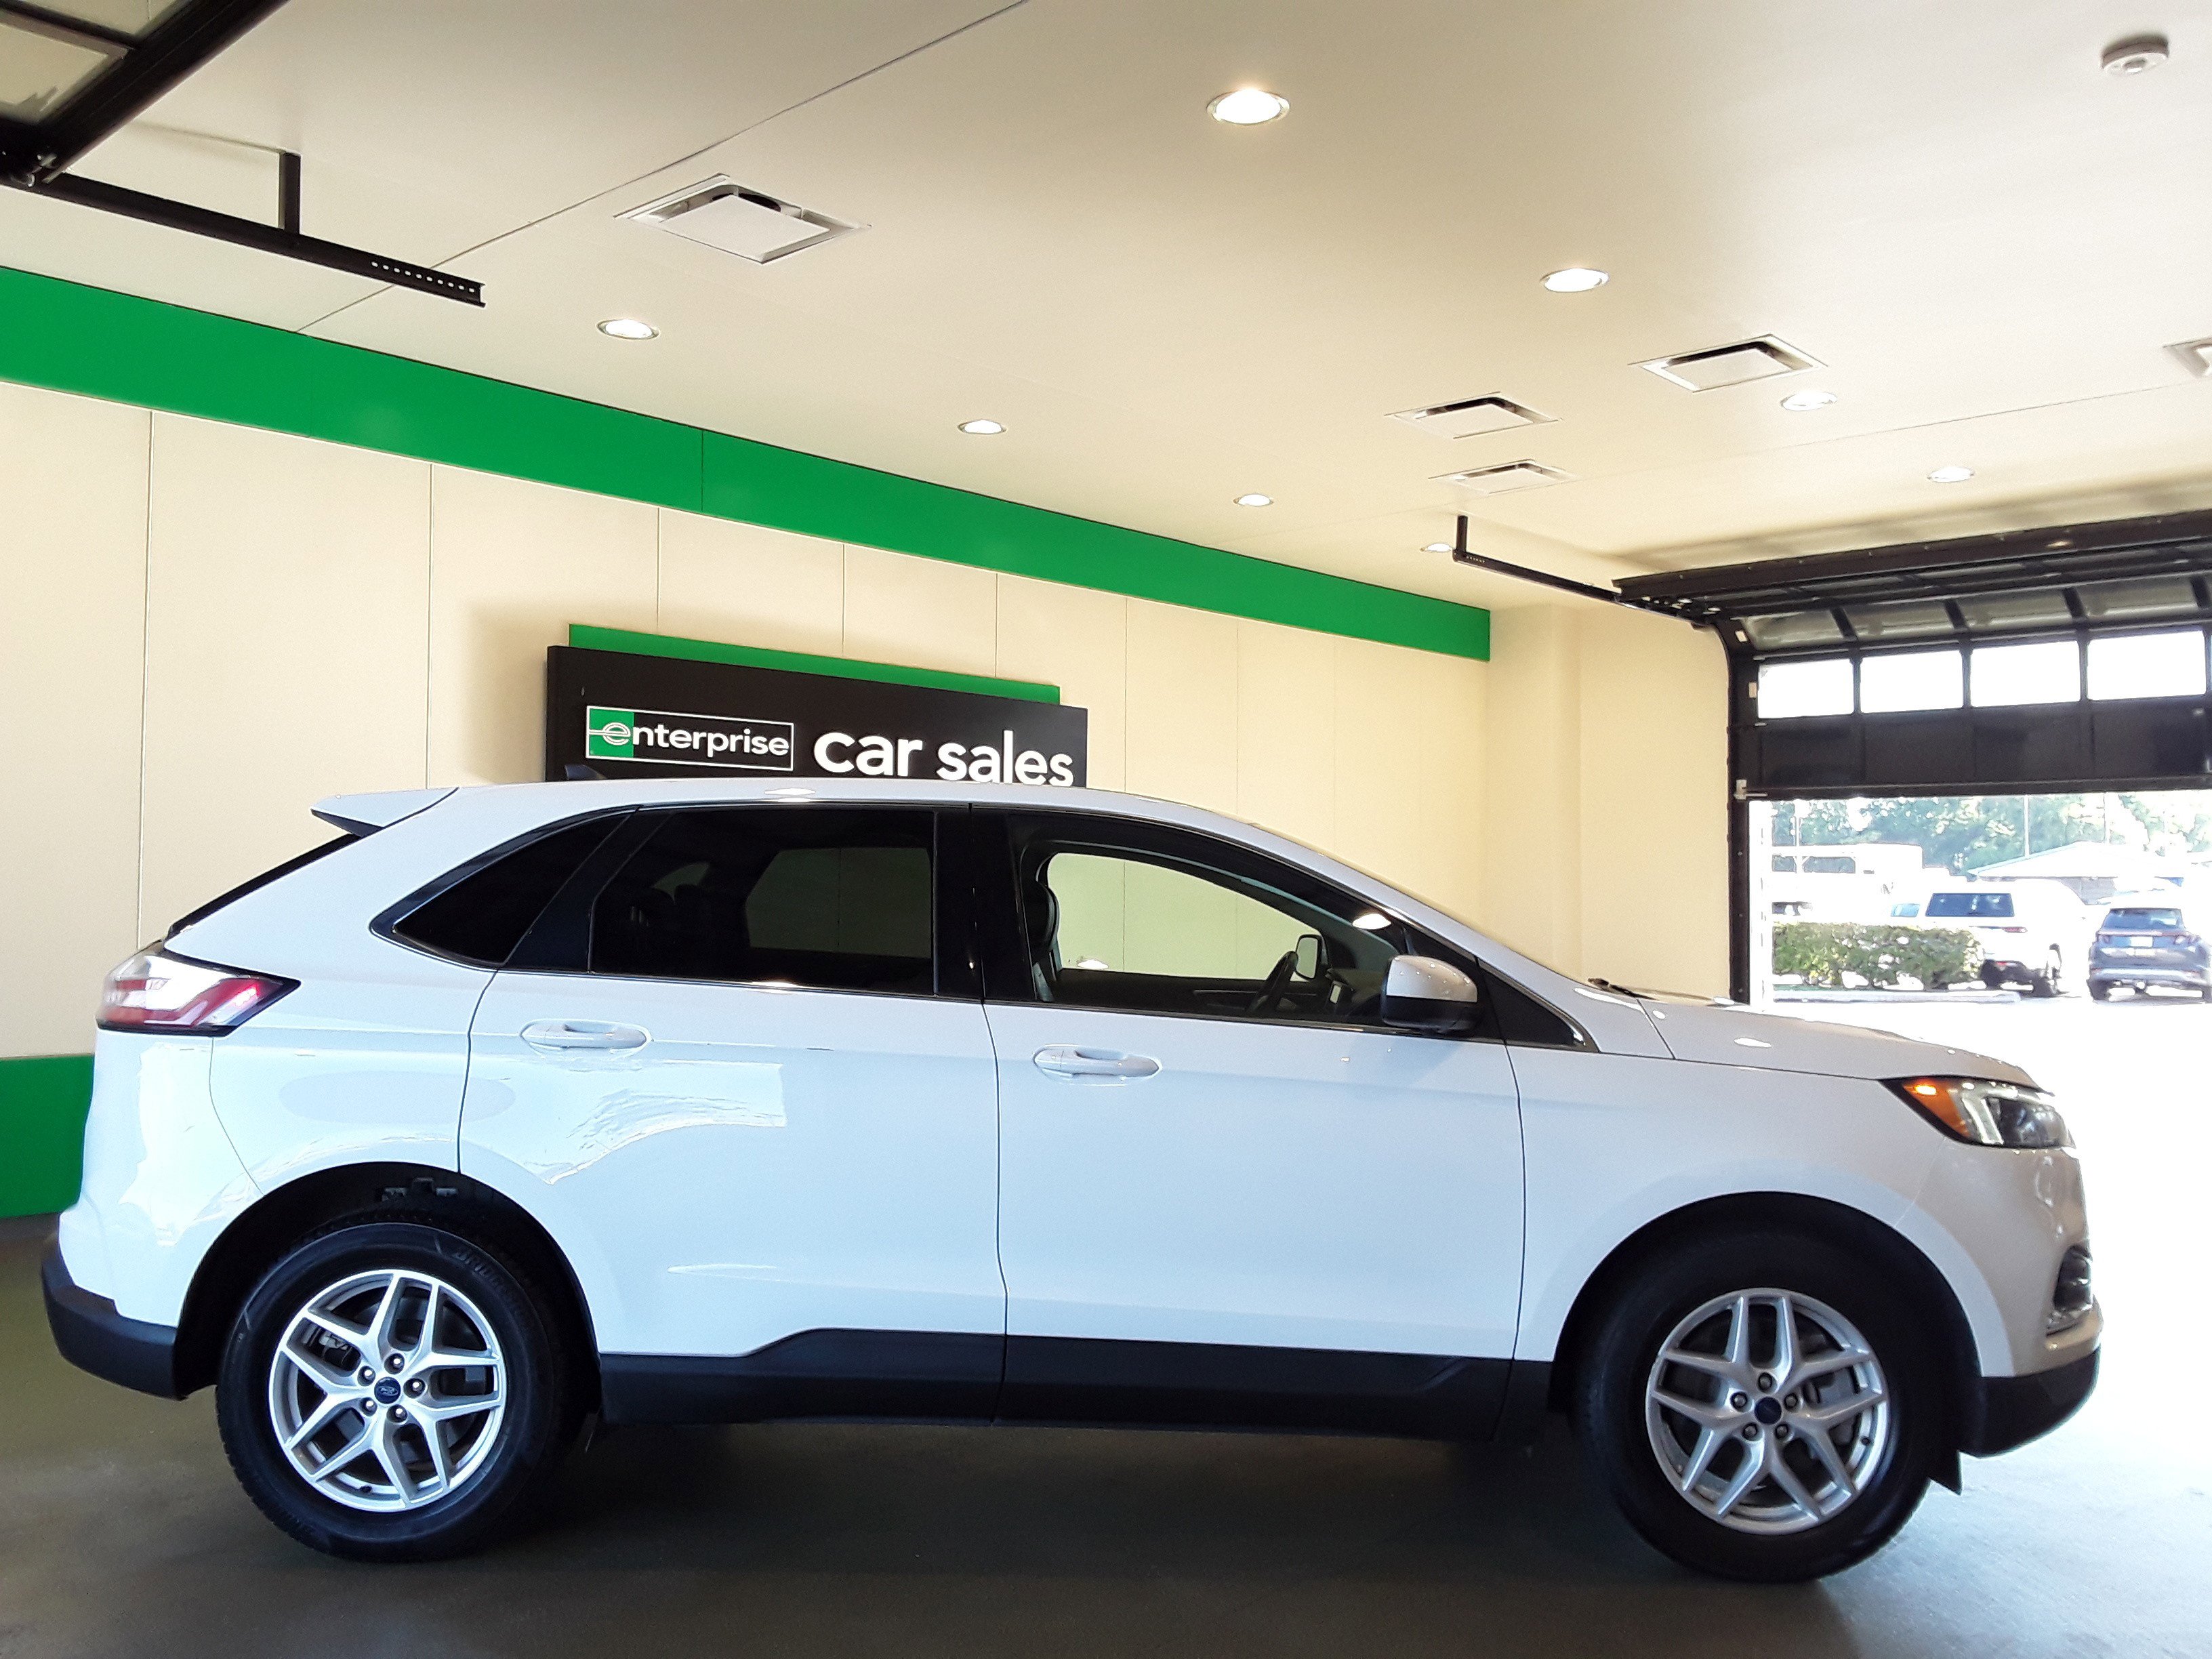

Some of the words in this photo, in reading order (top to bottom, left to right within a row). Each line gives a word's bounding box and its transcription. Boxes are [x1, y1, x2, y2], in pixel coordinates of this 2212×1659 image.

[590, 722, 789, 757] enterprise
[814, 732, 922, 777] car
[937, 730, 1073, 787] sales
